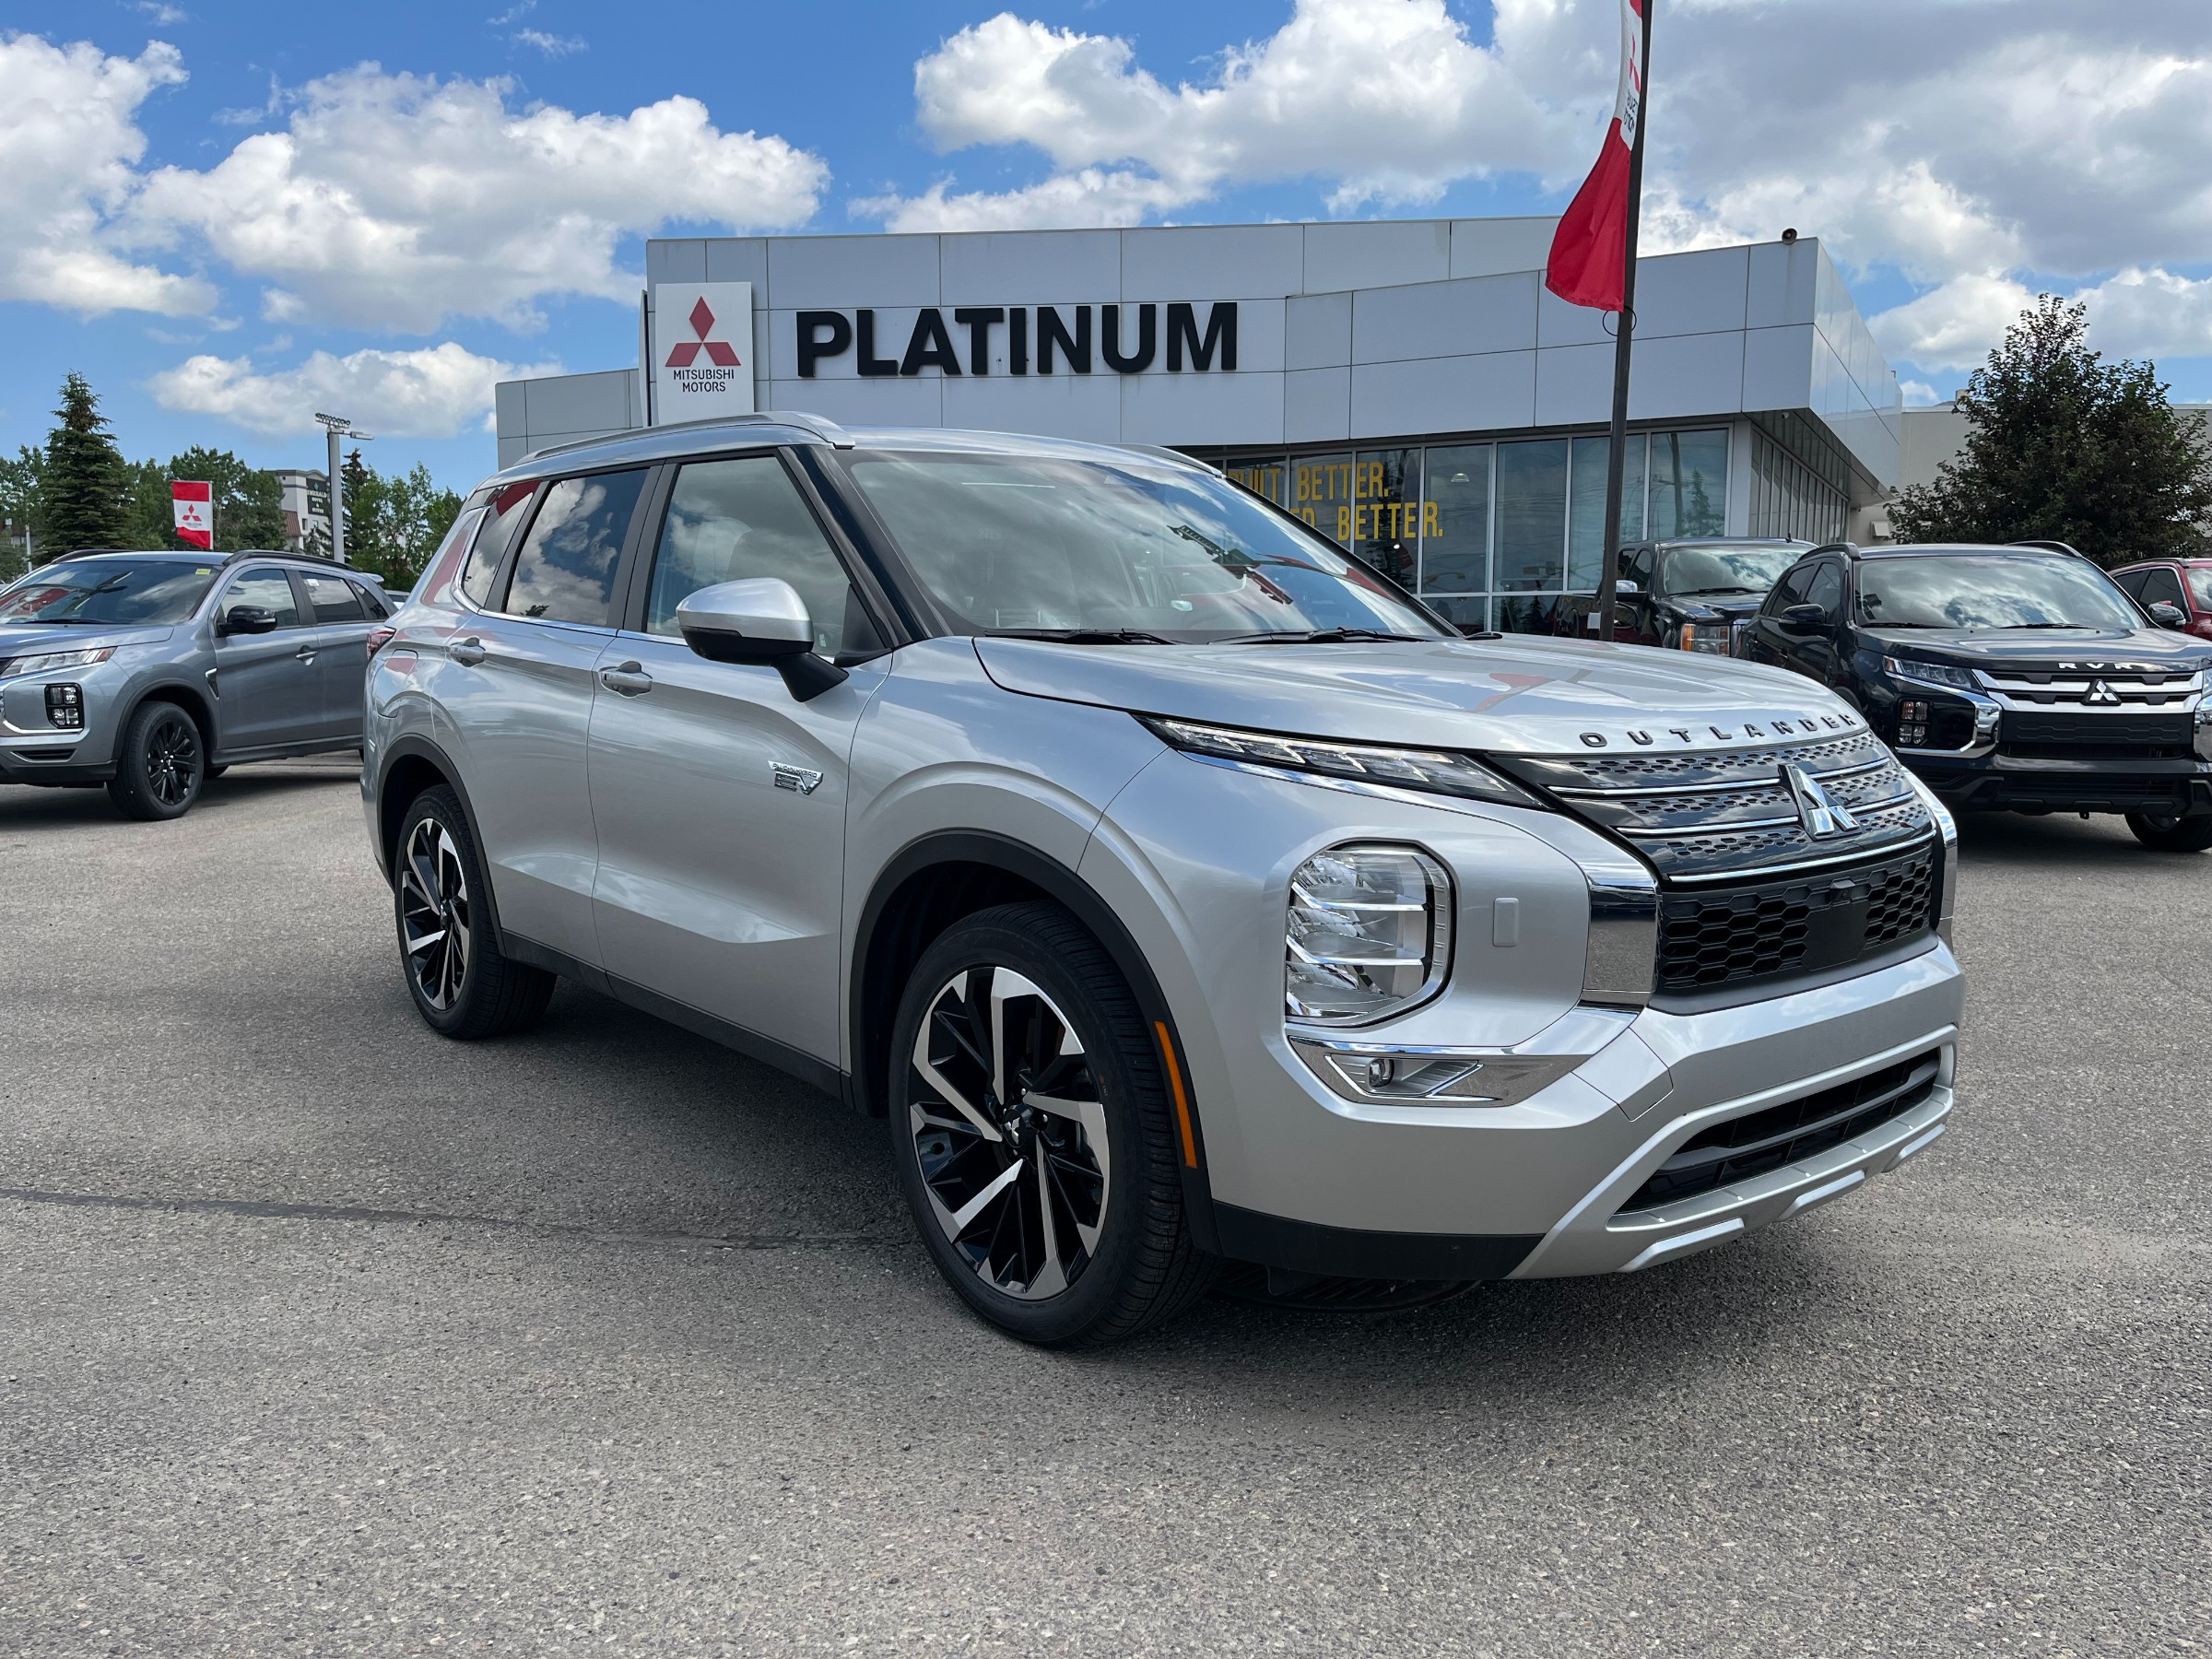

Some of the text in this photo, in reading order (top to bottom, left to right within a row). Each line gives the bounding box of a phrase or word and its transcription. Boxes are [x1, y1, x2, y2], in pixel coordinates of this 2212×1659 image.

[796, 302, 1238, 378] PLATINUM
[673, 369, 735, 381] MITSUBISHI
[682, 382, 726, 393] MOTORS
[1228, 462, 1389, 503] ILT BETTER.
[1337, 501, 1443, 541] BETTER.
[1579, 713, 1857, 747] OUTLANDER
